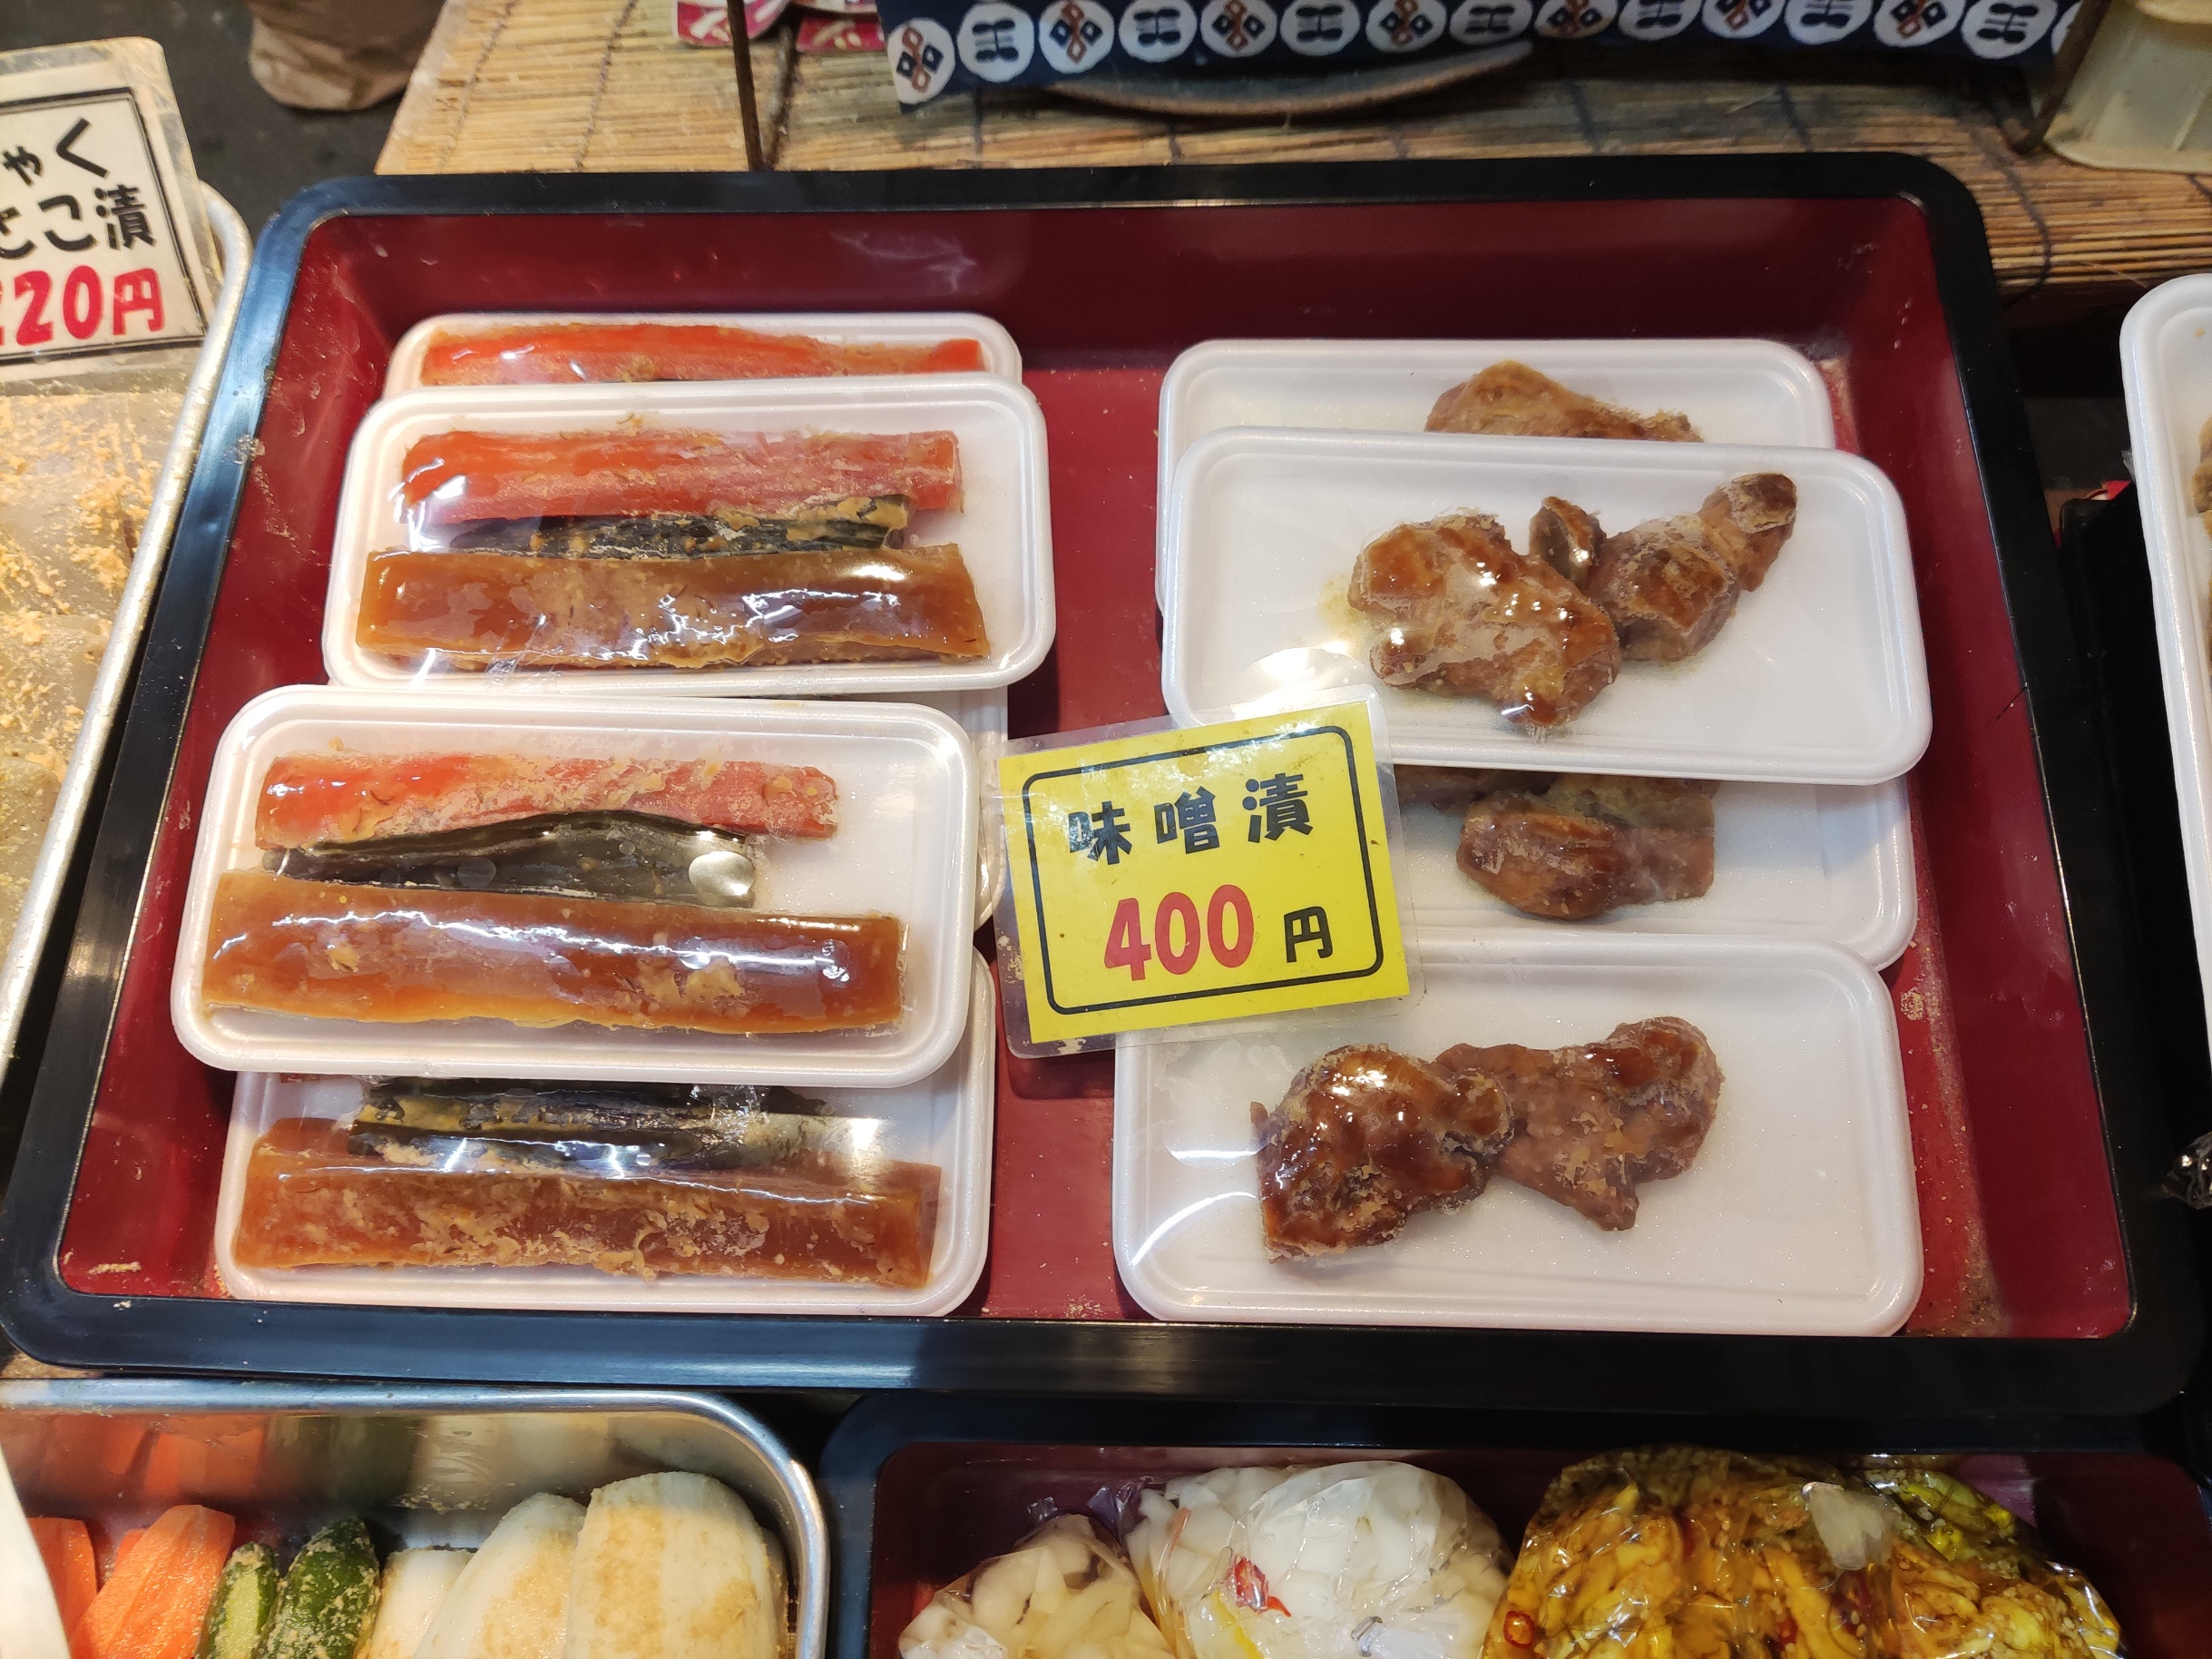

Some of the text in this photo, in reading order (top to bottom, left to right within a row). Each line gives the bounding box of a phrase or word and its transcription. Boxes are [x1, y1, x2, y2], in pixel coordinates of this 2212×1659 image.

[0, 265, 165, 346] 20円
[1069, 772, 1313, 865] 味噌漬
